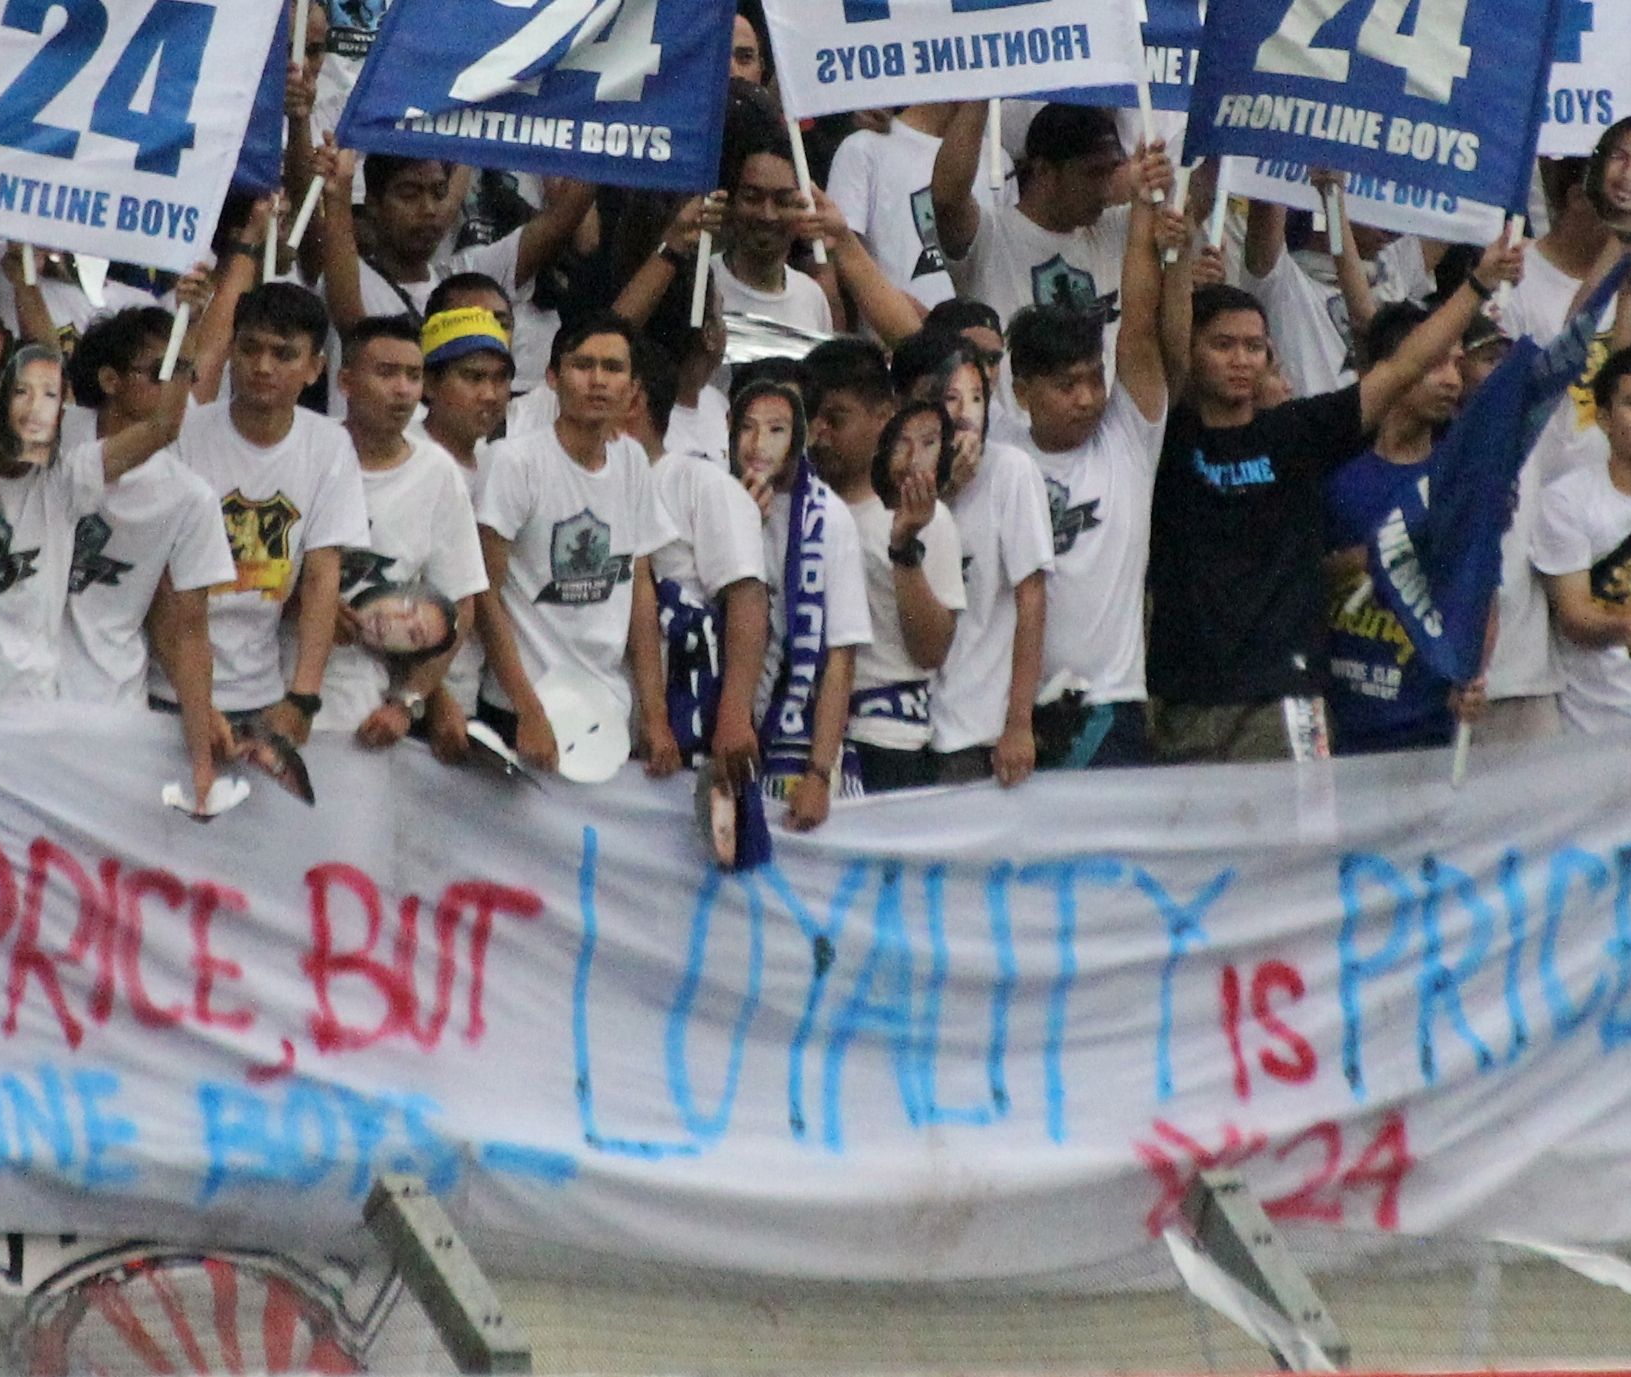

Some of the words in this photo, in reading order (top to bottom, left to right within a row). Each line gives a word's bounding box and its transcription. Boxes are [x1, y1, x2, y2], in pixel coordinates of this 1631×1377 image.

[582, 122, 672, 163] BOYS
[1213, 92, 1381, 147] FRONTLINE
[1386, 118, 1481, 173] BOYS
[116, 195, 201, 244] BOYS
[1219, 958, 1319, 1100] IS
